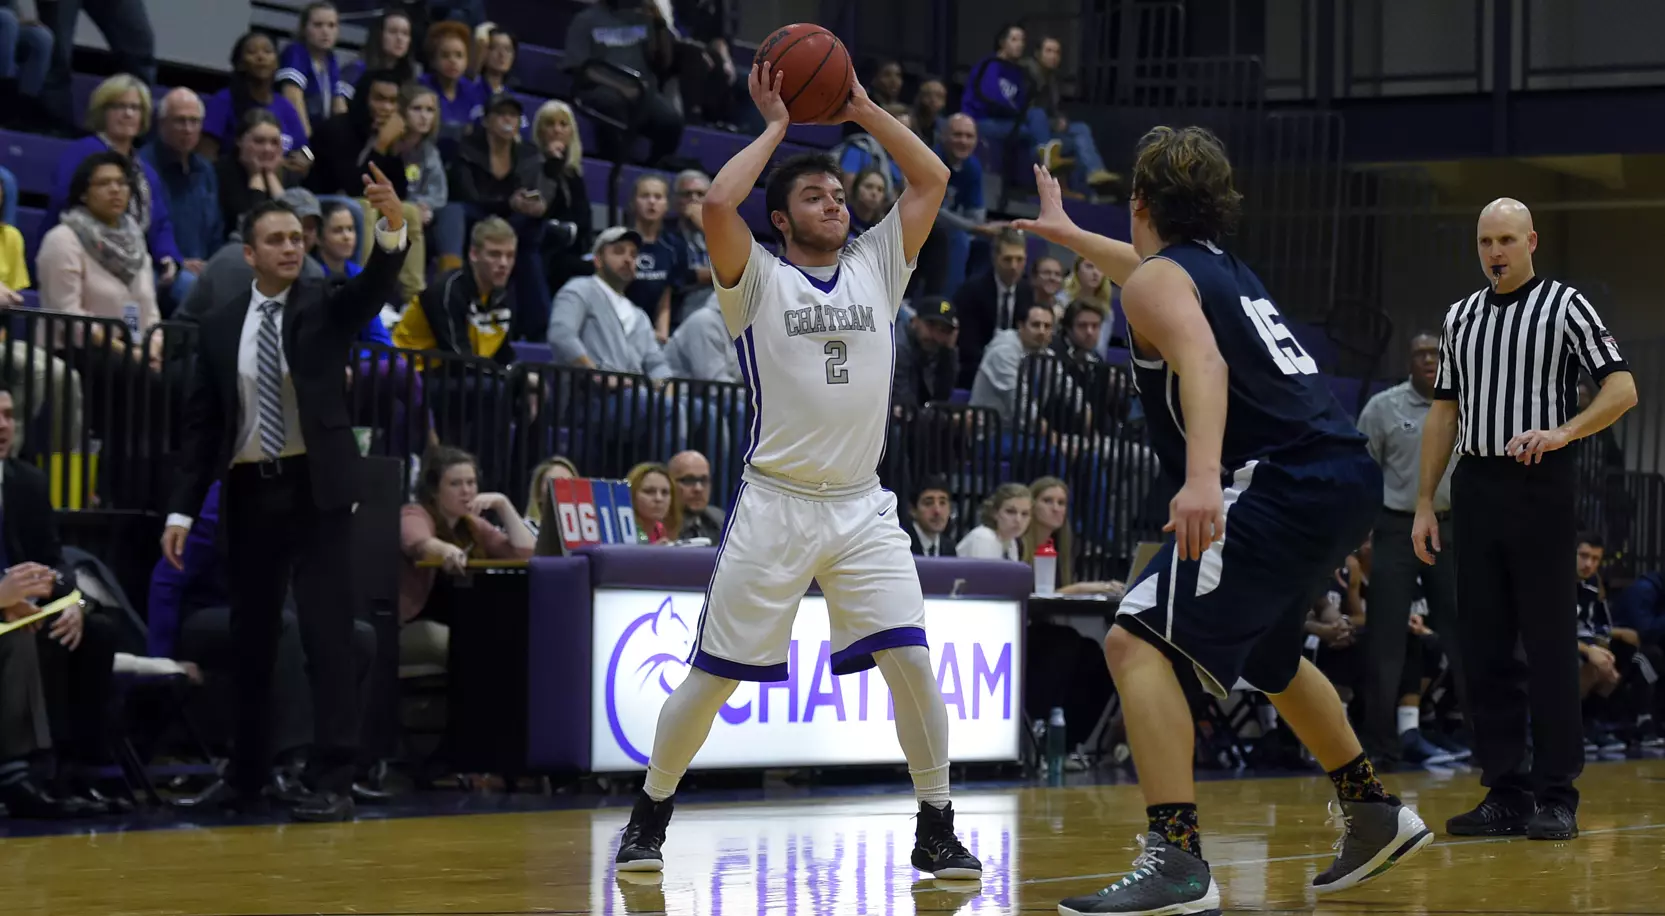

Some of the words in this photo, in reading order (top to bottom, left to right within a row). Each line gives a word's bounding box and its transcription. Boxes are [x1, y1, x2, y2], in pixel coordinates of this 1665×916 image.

[784, 304, 876, 337] CHATHAM
[1240, 295, 1319, 375] 15
[824, 340, 849, 384] 2
[558, 503, 600, 542] 06
[600, 506, 637, 544] 10
[718, 639, 1012, 725] HAAM
